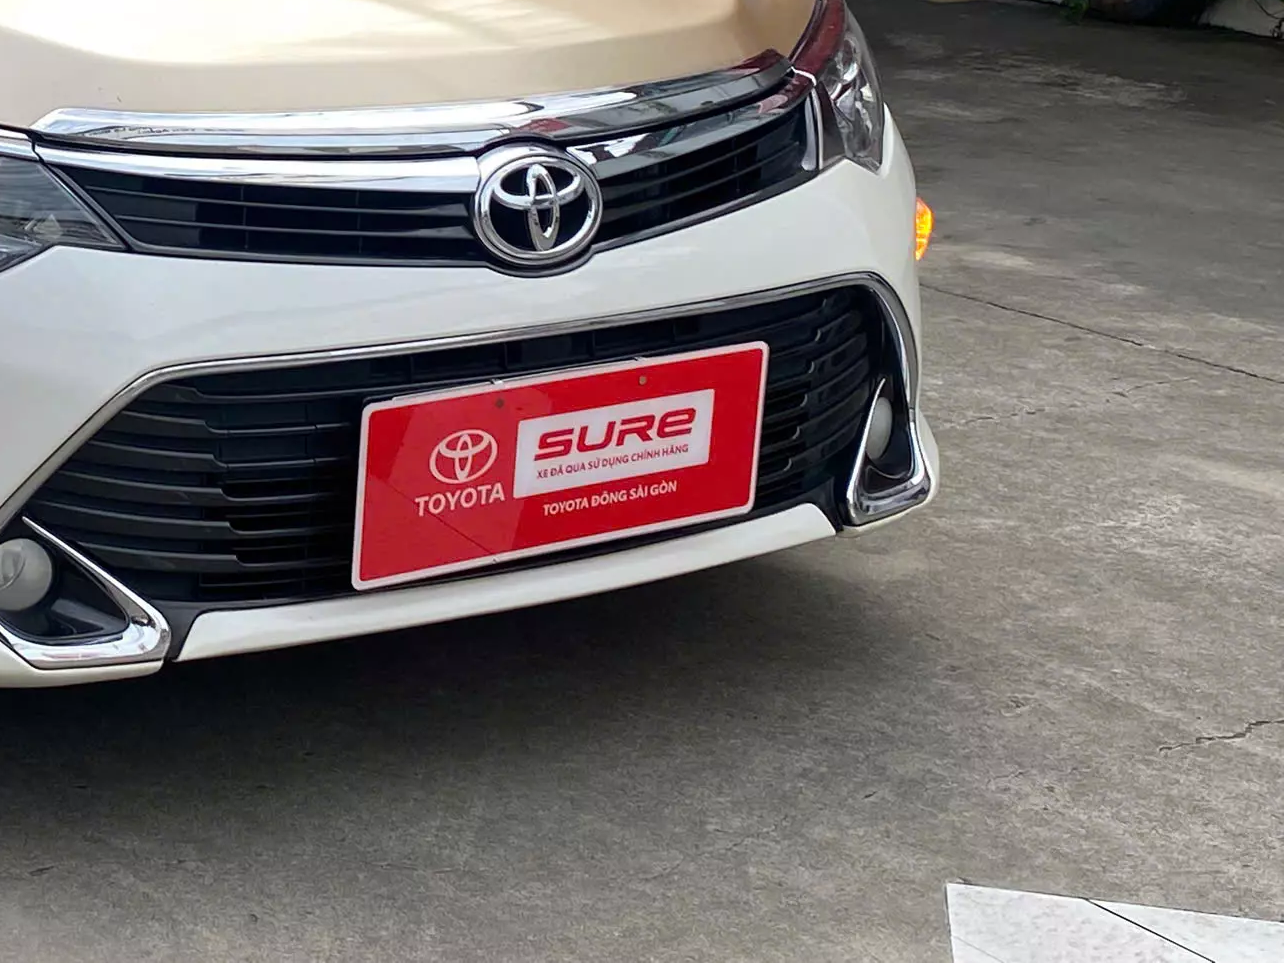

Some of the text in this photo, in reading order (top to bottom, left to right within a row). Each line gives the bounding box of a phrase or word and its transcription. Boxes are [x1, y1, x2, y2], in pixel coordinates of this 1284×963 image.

[536, 468, 548, 479] XE
[565, 462, 586, 475] QUA
[602, 454, 629, 469] DỤNG
[631, 448, 660, 462] CHÍNH
[415, 482, 506, 517] TOYOTA
[543, 480, 678, 516] TOYOTA ĐÔNG SÀI GÒN
